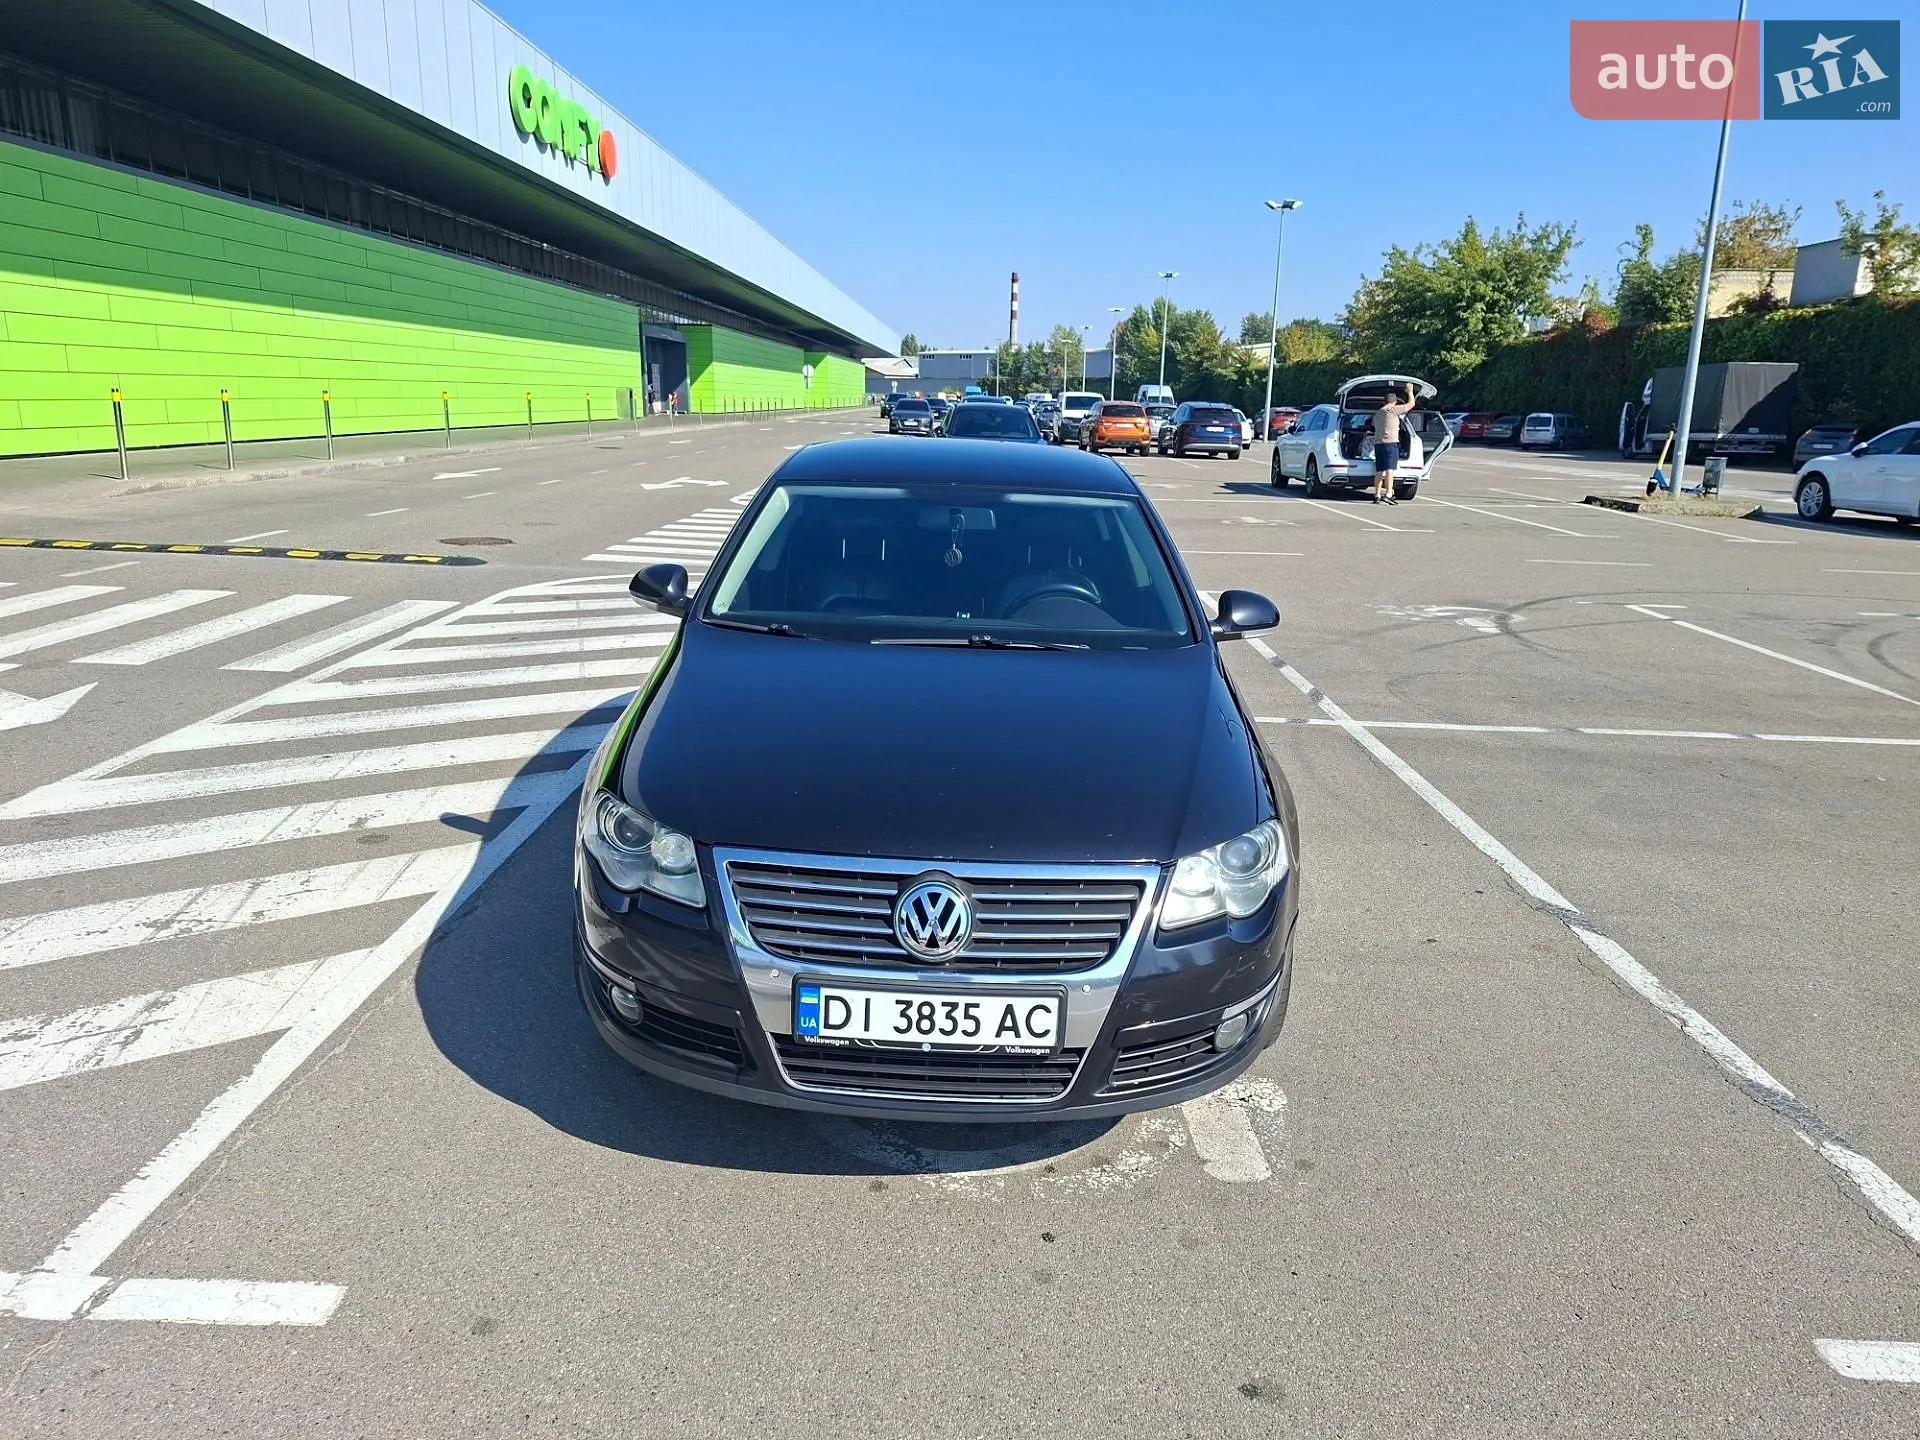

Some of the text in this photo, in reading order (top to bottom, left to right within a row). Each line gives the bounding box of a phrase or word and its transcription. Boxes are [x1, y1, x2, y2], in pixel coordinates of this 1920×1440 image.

[508, 63, 602, 171] COMFY
[823, 994, 1052, 1039] DI 3835 AC
[800, 1017, 818, 1029] UA
[804, 1035, 850, 1047] Volkswagen
[1005, 1045, 1051, 1056] Volkswagen
